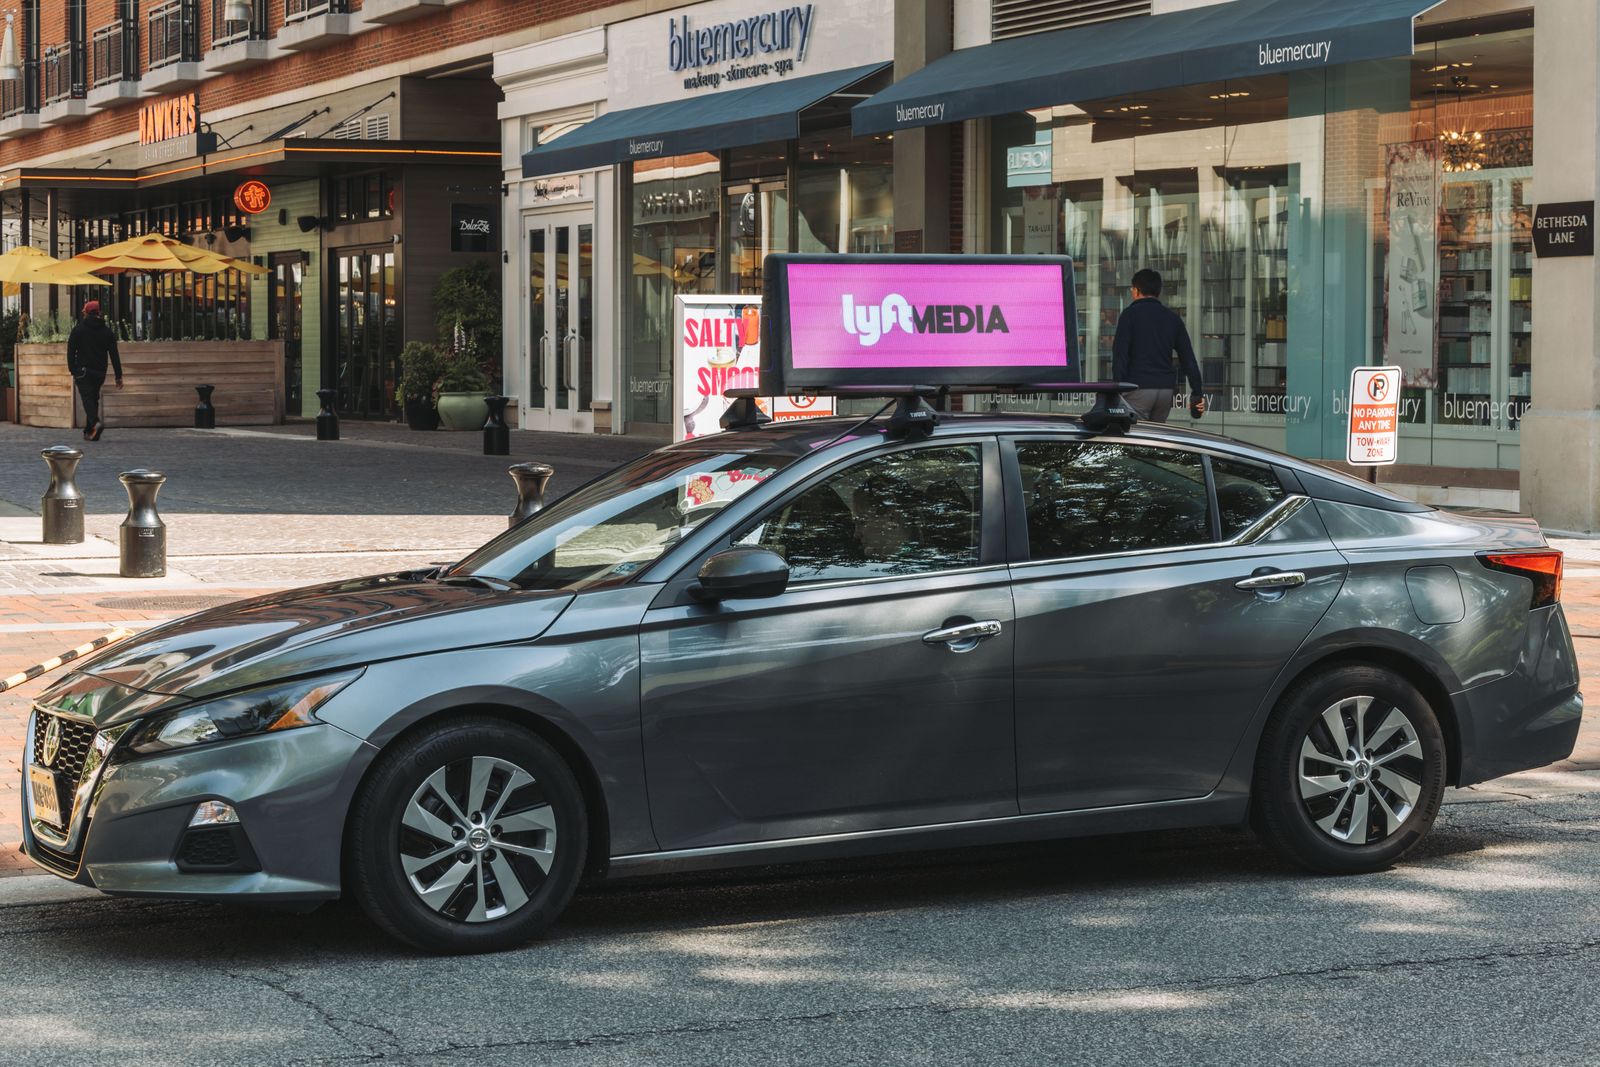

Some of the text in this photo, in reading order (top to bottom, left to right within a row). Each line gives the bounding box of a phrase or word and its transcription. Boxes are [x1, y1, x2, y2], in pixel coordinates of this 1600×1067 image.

[668, 3, 815, 73] bluemercury
[1258, 40, 1332, 66] bluemercury
[683, 57, 794, 90] makeup skincare spa
[138, 92, 197, 147] HAWKERS
[895, 102, 945, 123] bluemercury
[629, 139, 664, 155] bluemercury
[1536, 215, 1588, 229] BETHESDA
[1548, 231, 1576, 244] LANE
[841, 292, 1010, 347] lyft MEDIA
[684, 318, 750, 348] SALTY
[629, 376, 670, 399] bluemercury
[697, 366, 760, 396] SMOO
[1231, 386, 1312, 420] bluemercury
[1353, 407, 1395, 418] NO PARKING
[1443, 391, 1532, 421] bluemercur
[1358, 420, 1377, 431] ANY
[1377, 419, 1391, 430] TIME
[1366, 447, 1384, 458] ZONE
